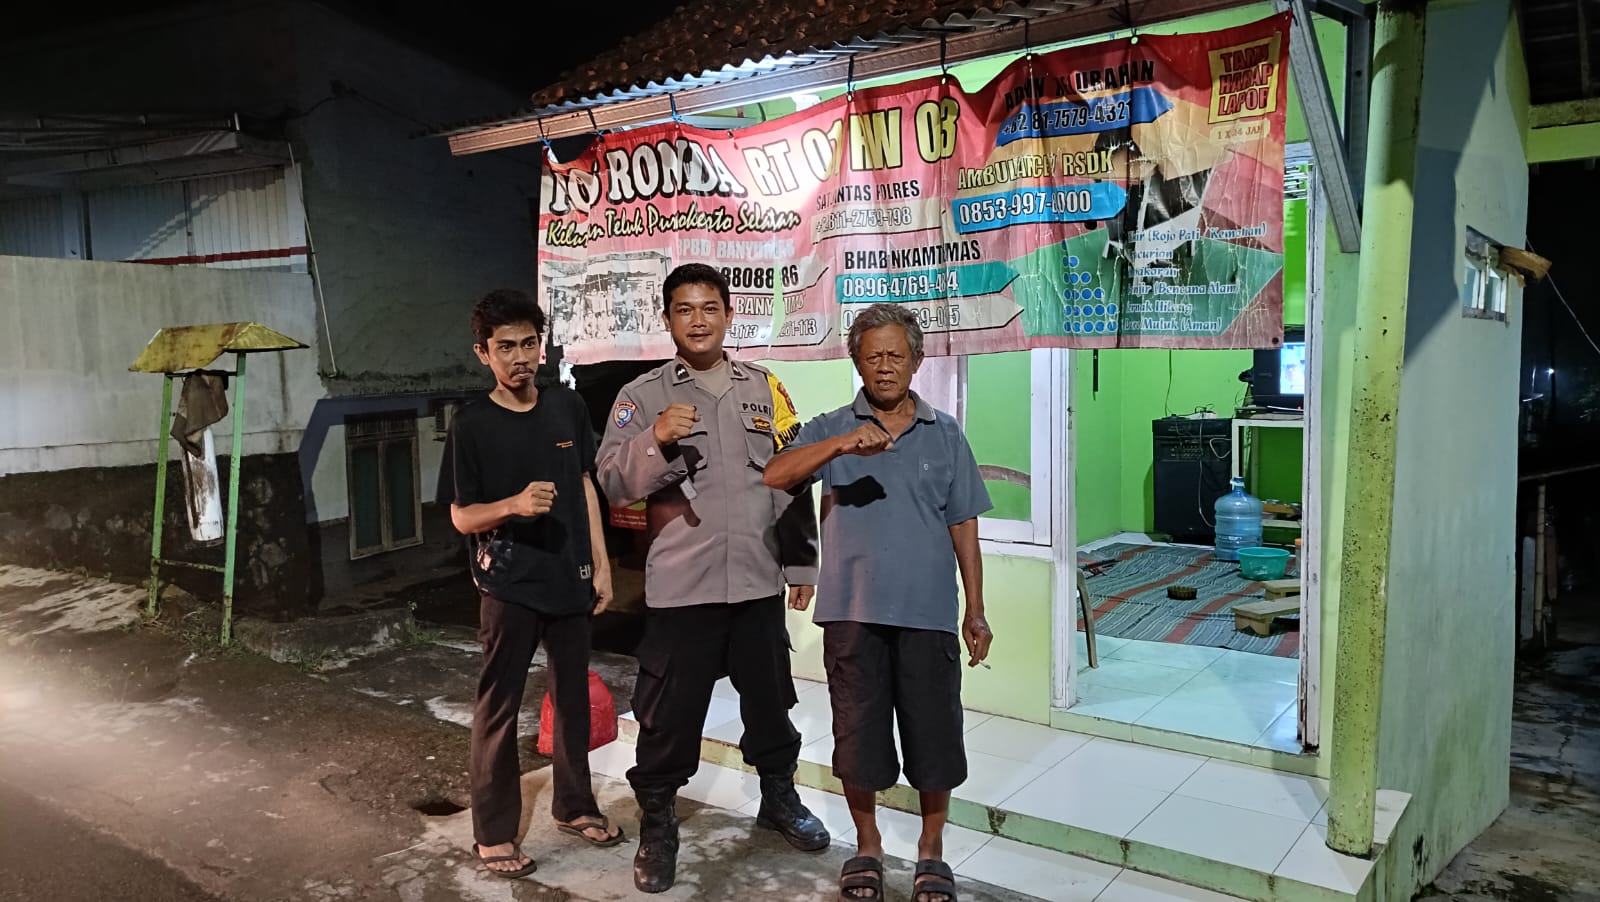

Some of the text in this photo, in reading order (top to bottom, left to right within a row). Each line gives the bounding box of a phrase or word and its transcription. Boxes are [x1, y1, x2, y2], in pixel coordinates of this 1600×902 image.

[605, 137, 748, 205] RONDA
[742, 138, 800, 196] RT
[914, 96, 960, 164] 03
[1062, 150, 1114, 177] RSDK
[605, 207, 645, 238] Teluk
[735, 201, 801, 233] Selatan
[742, 403, 772, 416] POLRI
